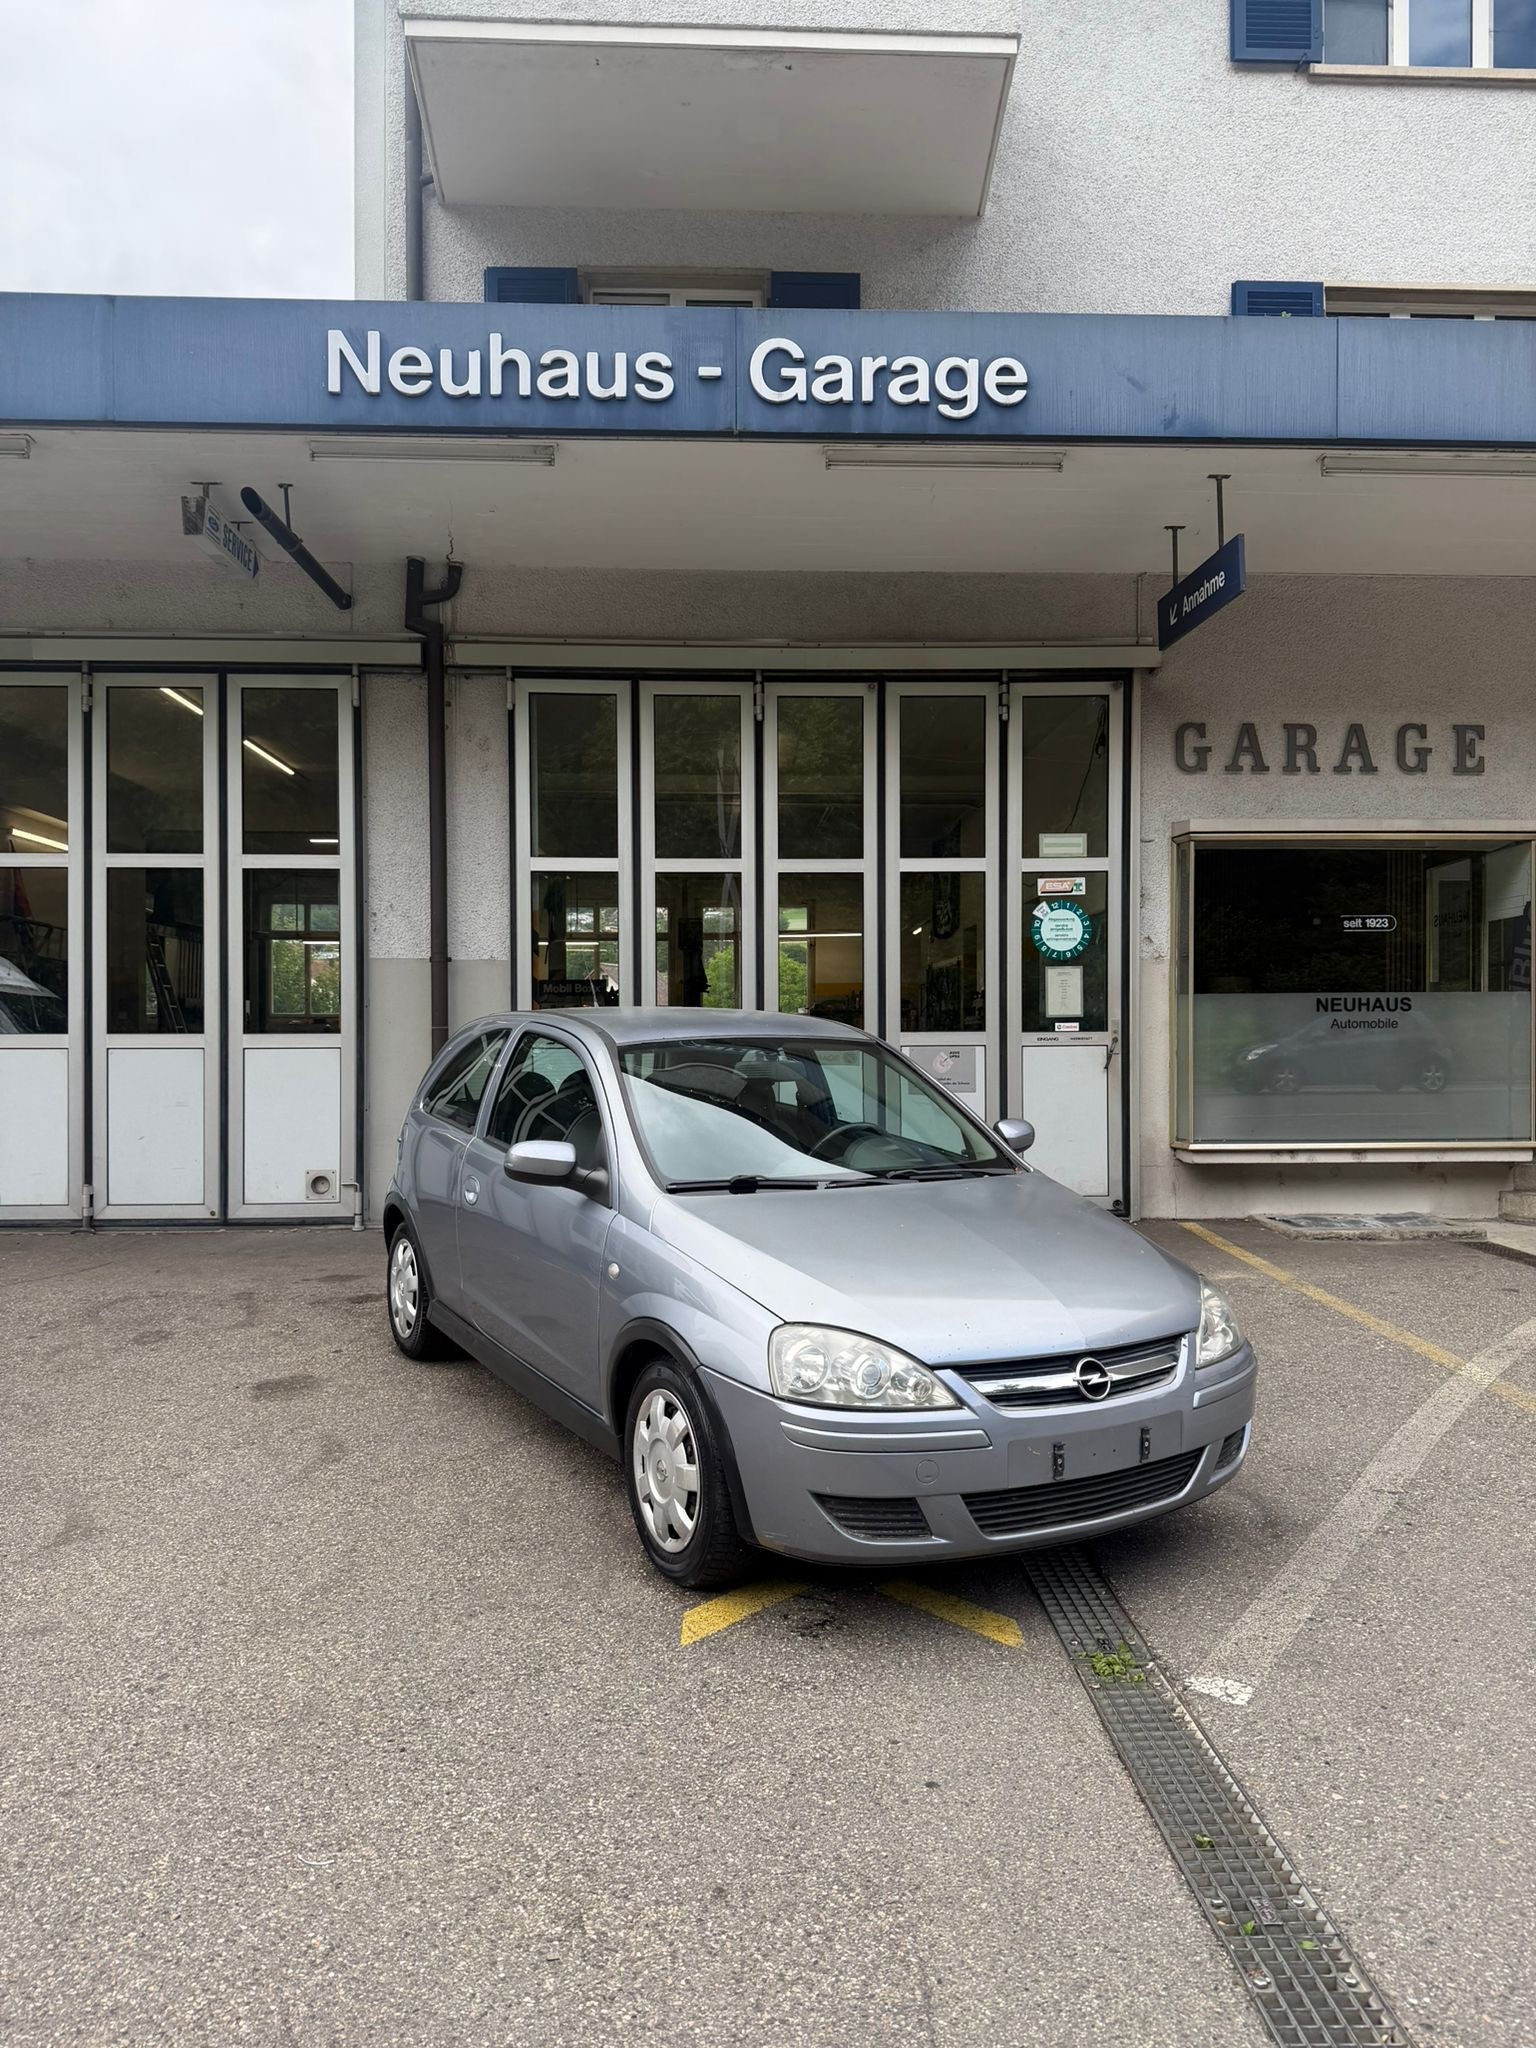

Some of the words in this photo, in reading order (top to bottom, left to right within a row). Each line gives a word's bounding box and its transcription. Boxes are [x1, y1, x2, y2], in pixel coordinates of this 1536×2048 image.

[327, 329, 675, 402] Neuhaus
[698, 366, 722, 379] -
[749, 337, 1028, 420] Garage
[223, 523, 253, 572] SERVICE
[1182, 570, 1226, 617] Annahme
[1175, 722, 1486, 774] GARAGE
[1051, 902, 1059, 910] 12
[1076, 908, 1083, 916] 2
[1343, 918, 1362, 928] seit
[1365, 918, 1389, 928] 1923
[543, 983, 572, 993] Mobil
[1316, 997, 1412, 1013] NEUHAUS
[1330, 1018, 1399, 1030] Automobile
